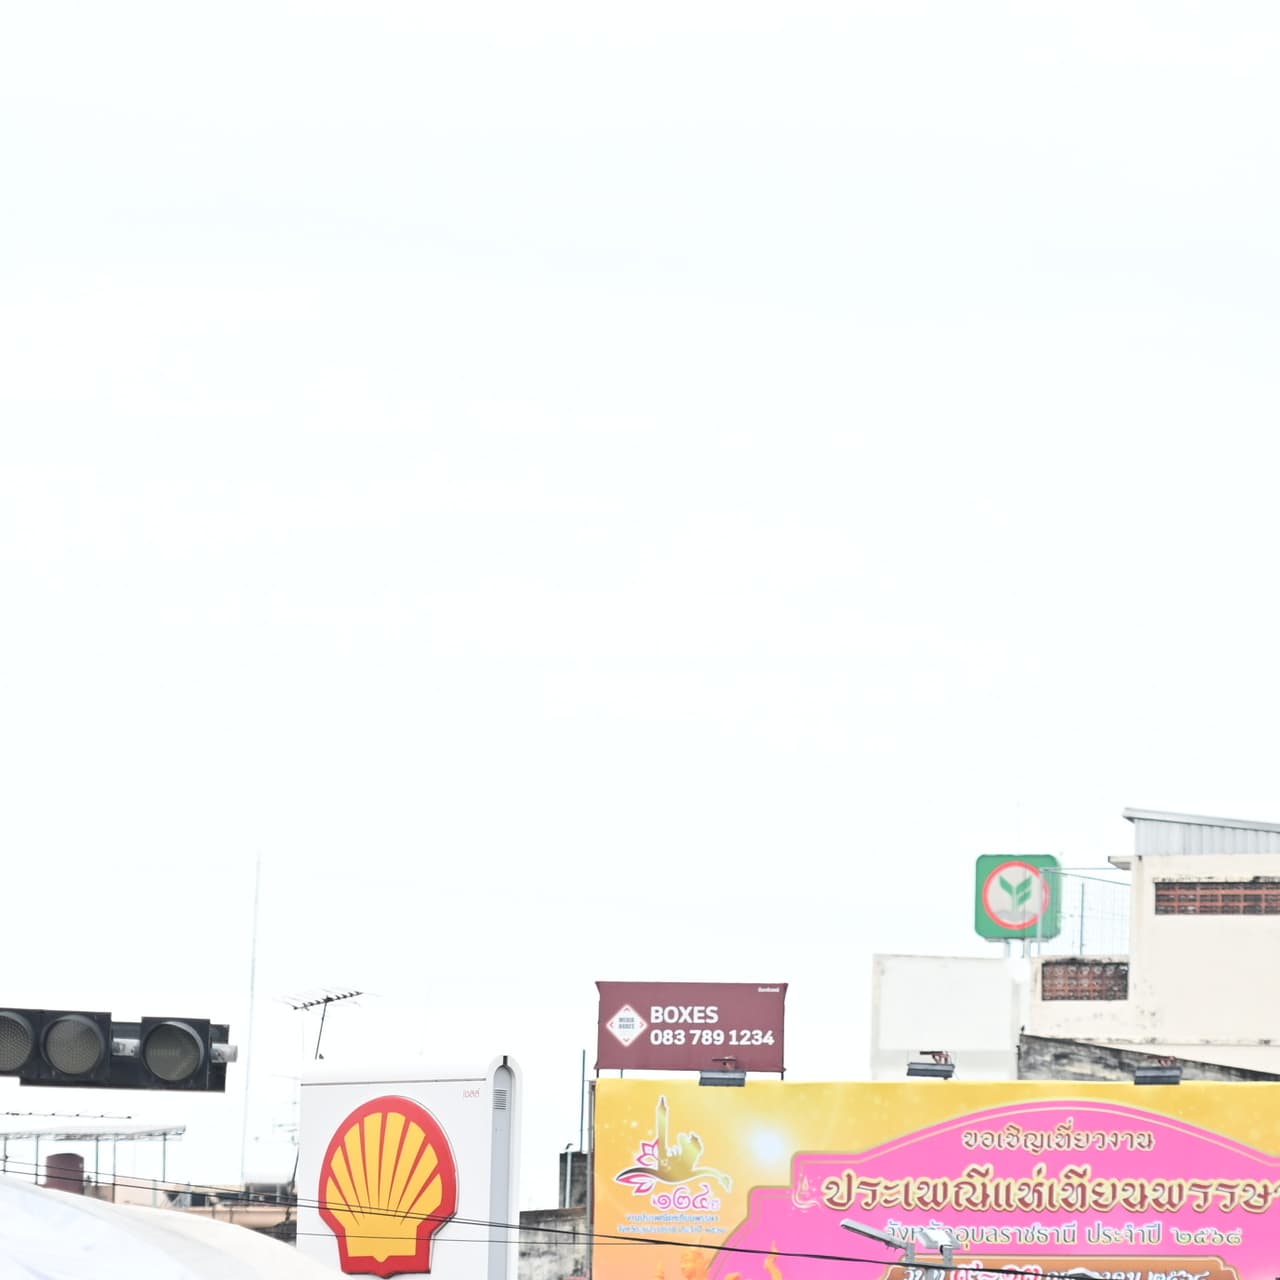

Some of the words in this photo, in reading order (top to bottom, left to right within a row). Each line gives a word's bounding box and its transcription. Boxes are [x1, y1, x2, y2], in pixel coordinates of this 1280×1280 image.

[650, 1006, 719, 1024] BOXES
[650, 1029, 686, 1046] 083
[689, 1029, 725, 1046] 789
[728, 1029, 776, 1046] 1234
[963, 1119, 1156, 1153] ขอเชิญเที่ยวงาน
[1086, 1221, 1162, 1245] ประจำปี
